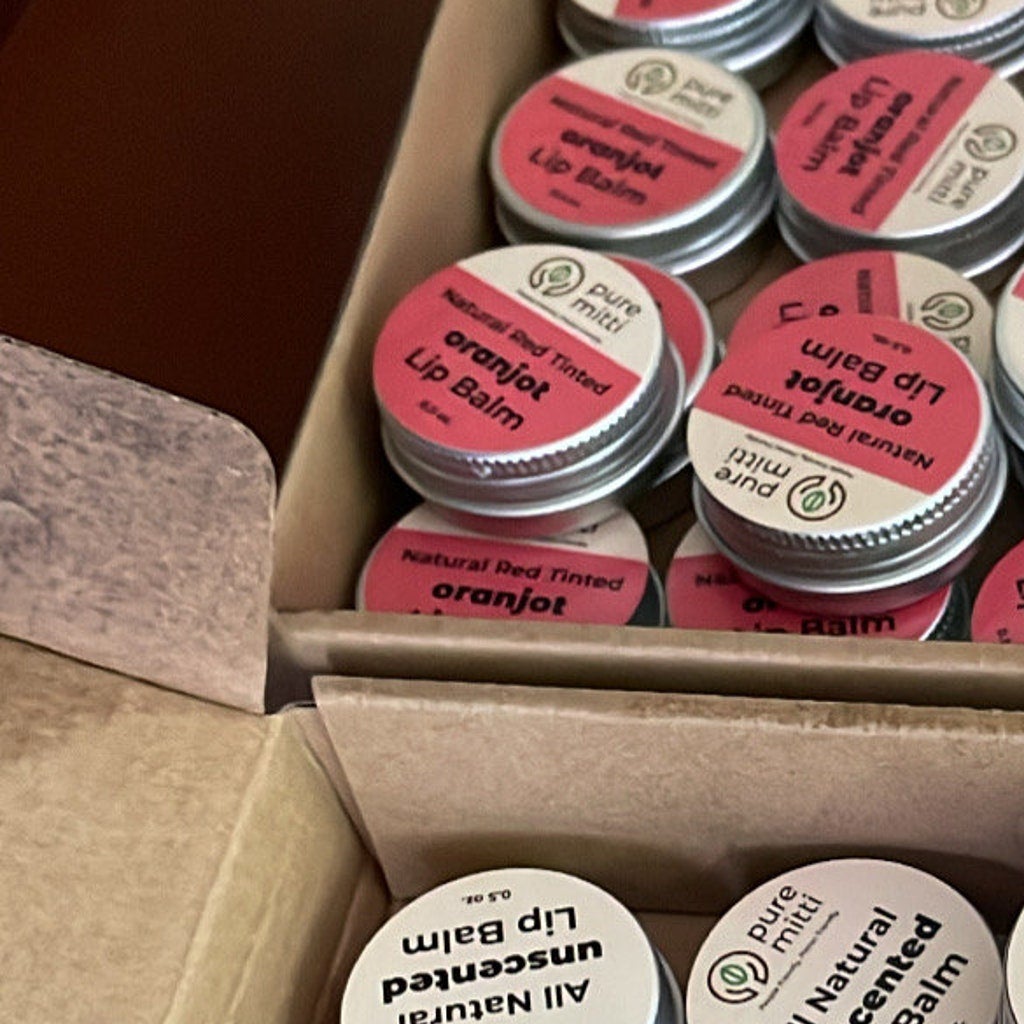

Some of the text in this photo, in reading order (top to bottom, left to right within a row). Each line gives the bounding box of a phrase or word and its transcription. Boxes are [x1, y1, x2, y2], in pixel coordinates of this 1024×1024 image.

[569, 298, 629, 334] mitti
[585, 282, 642, 318] pure
[439, 287, 613, 397] Natural Red Tinted
[443, 330, 550, 402] oranjot
[799, 337, 886, 384] Balm
[403, 346, 450, 383] Lip
[450, 375, 525, 432] Balm
[784, 368, 913, 426] oranjot
[892, 371, 945, 405] Lip
[721, 382, 935, 470] Natural Red Tinted
[713, 465, 780, 498] pure
[724, 446, 792, 479] mitti
[401, 548, 625, 592] Natural Red Tinted
[431, 582, 567, 615] oranjot
[460, 888, 511, 905] 0.5 oz.
[747, 885, 798, 944] pure
[401, 905, 577, 955] Lip Balm
[771, 892, 824, 954] mitti
[381, 939, 603, 1005] unscented
[804, 905, 898, 1014] Natural
[543, 977, 591, 1010] All
